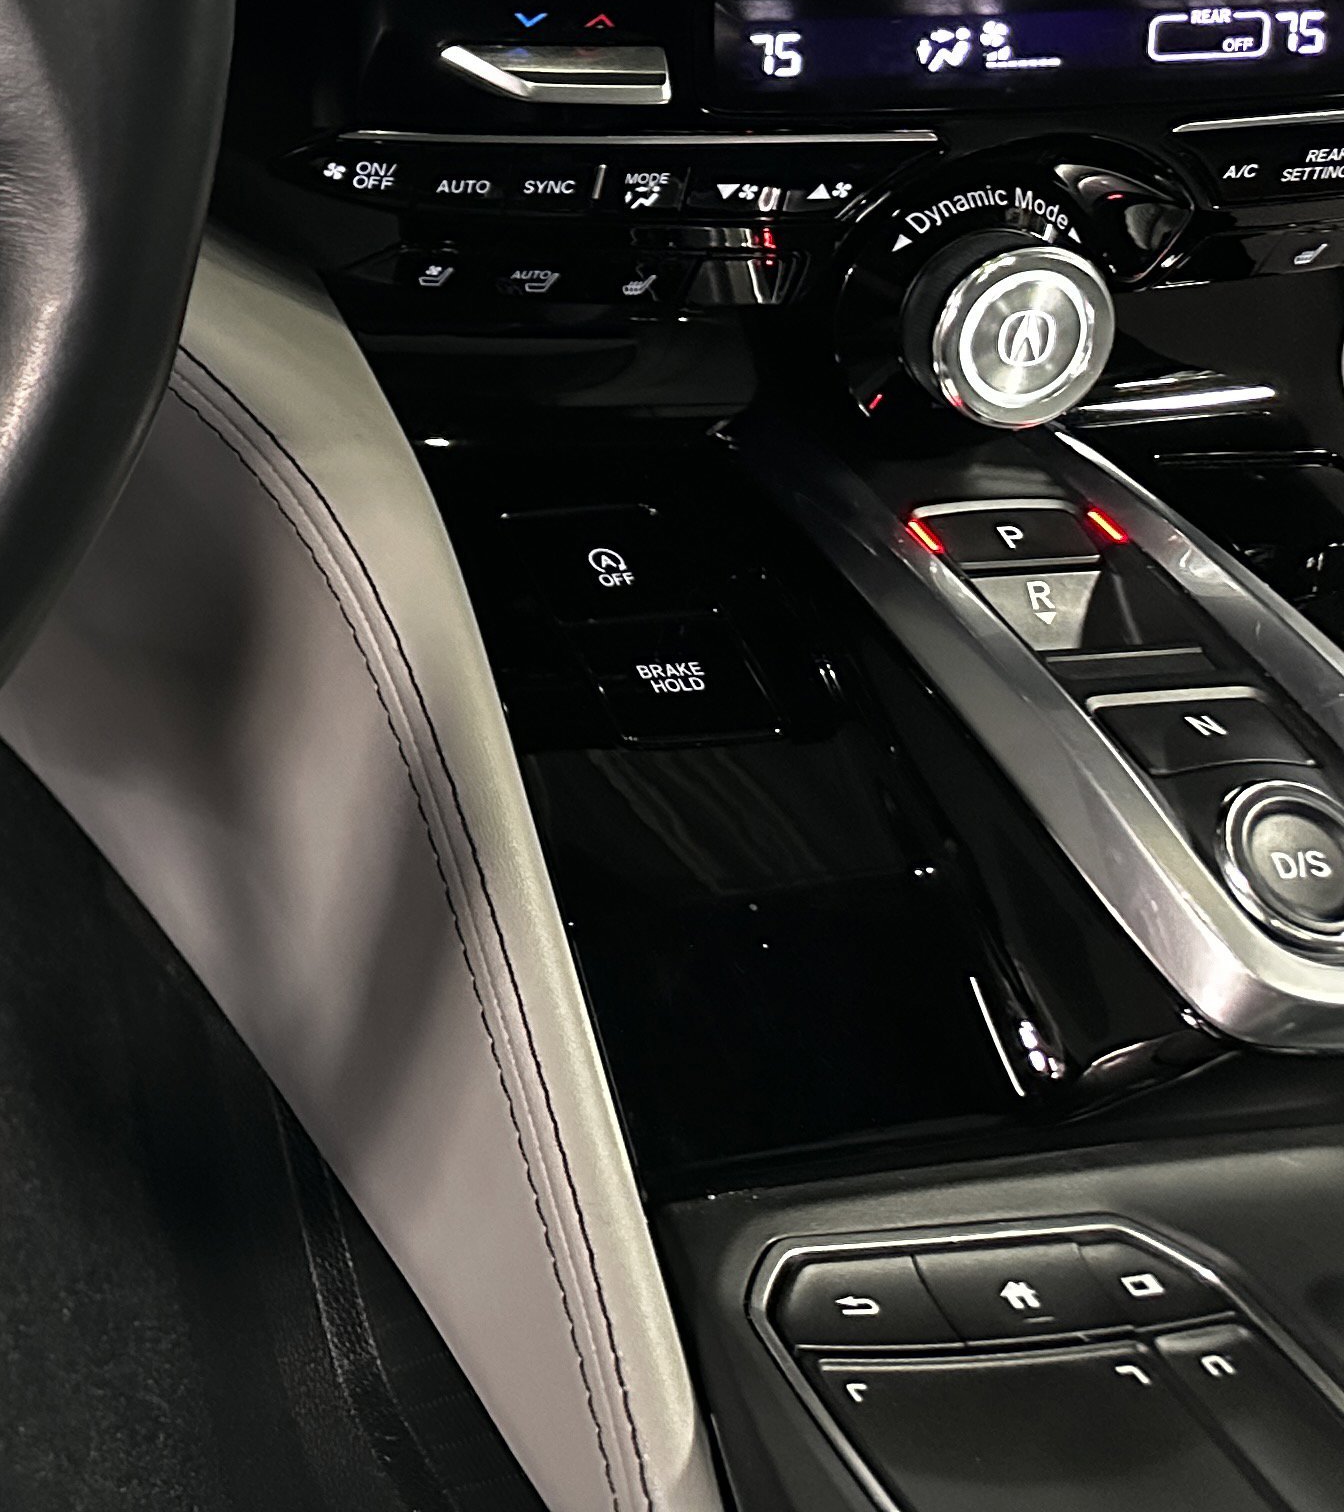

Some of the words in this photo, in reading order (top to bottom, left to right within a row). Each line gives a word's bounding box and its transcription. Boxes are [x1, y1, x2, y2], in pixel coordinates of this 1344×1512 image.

[1190, 8, 1232, 25] REAR
[1275, 10, 1326, 55] 75
[1221, 36, 1255, 54] OFF
[749, 31, 803, 78] 75
[354, 161, 398, 177] ON/
[1223, 163, 1259, 179] A/C
[352, 175, 395, 190] OFF
[436, 179, 491, 194] AUTO
[523, 179, 576, 195] SYNC
[624, 172, 671, 185] MODE
[905, 185, 1009, 236] Dynamic
[1014, 187, 1070, 230] Mode
[511, 269, 552, 281] AUTO
[996, 525, 1024, 549] P
[598, 572, 635, 588] OFF
[1026, 580, 1055, 610] R
[635, 661, 706, 679] BRAKE
[650, 676, 706, 694] HOLD
[1184, 715, 1227, 737] N
[1271, 850, 1332, 880] D/S
